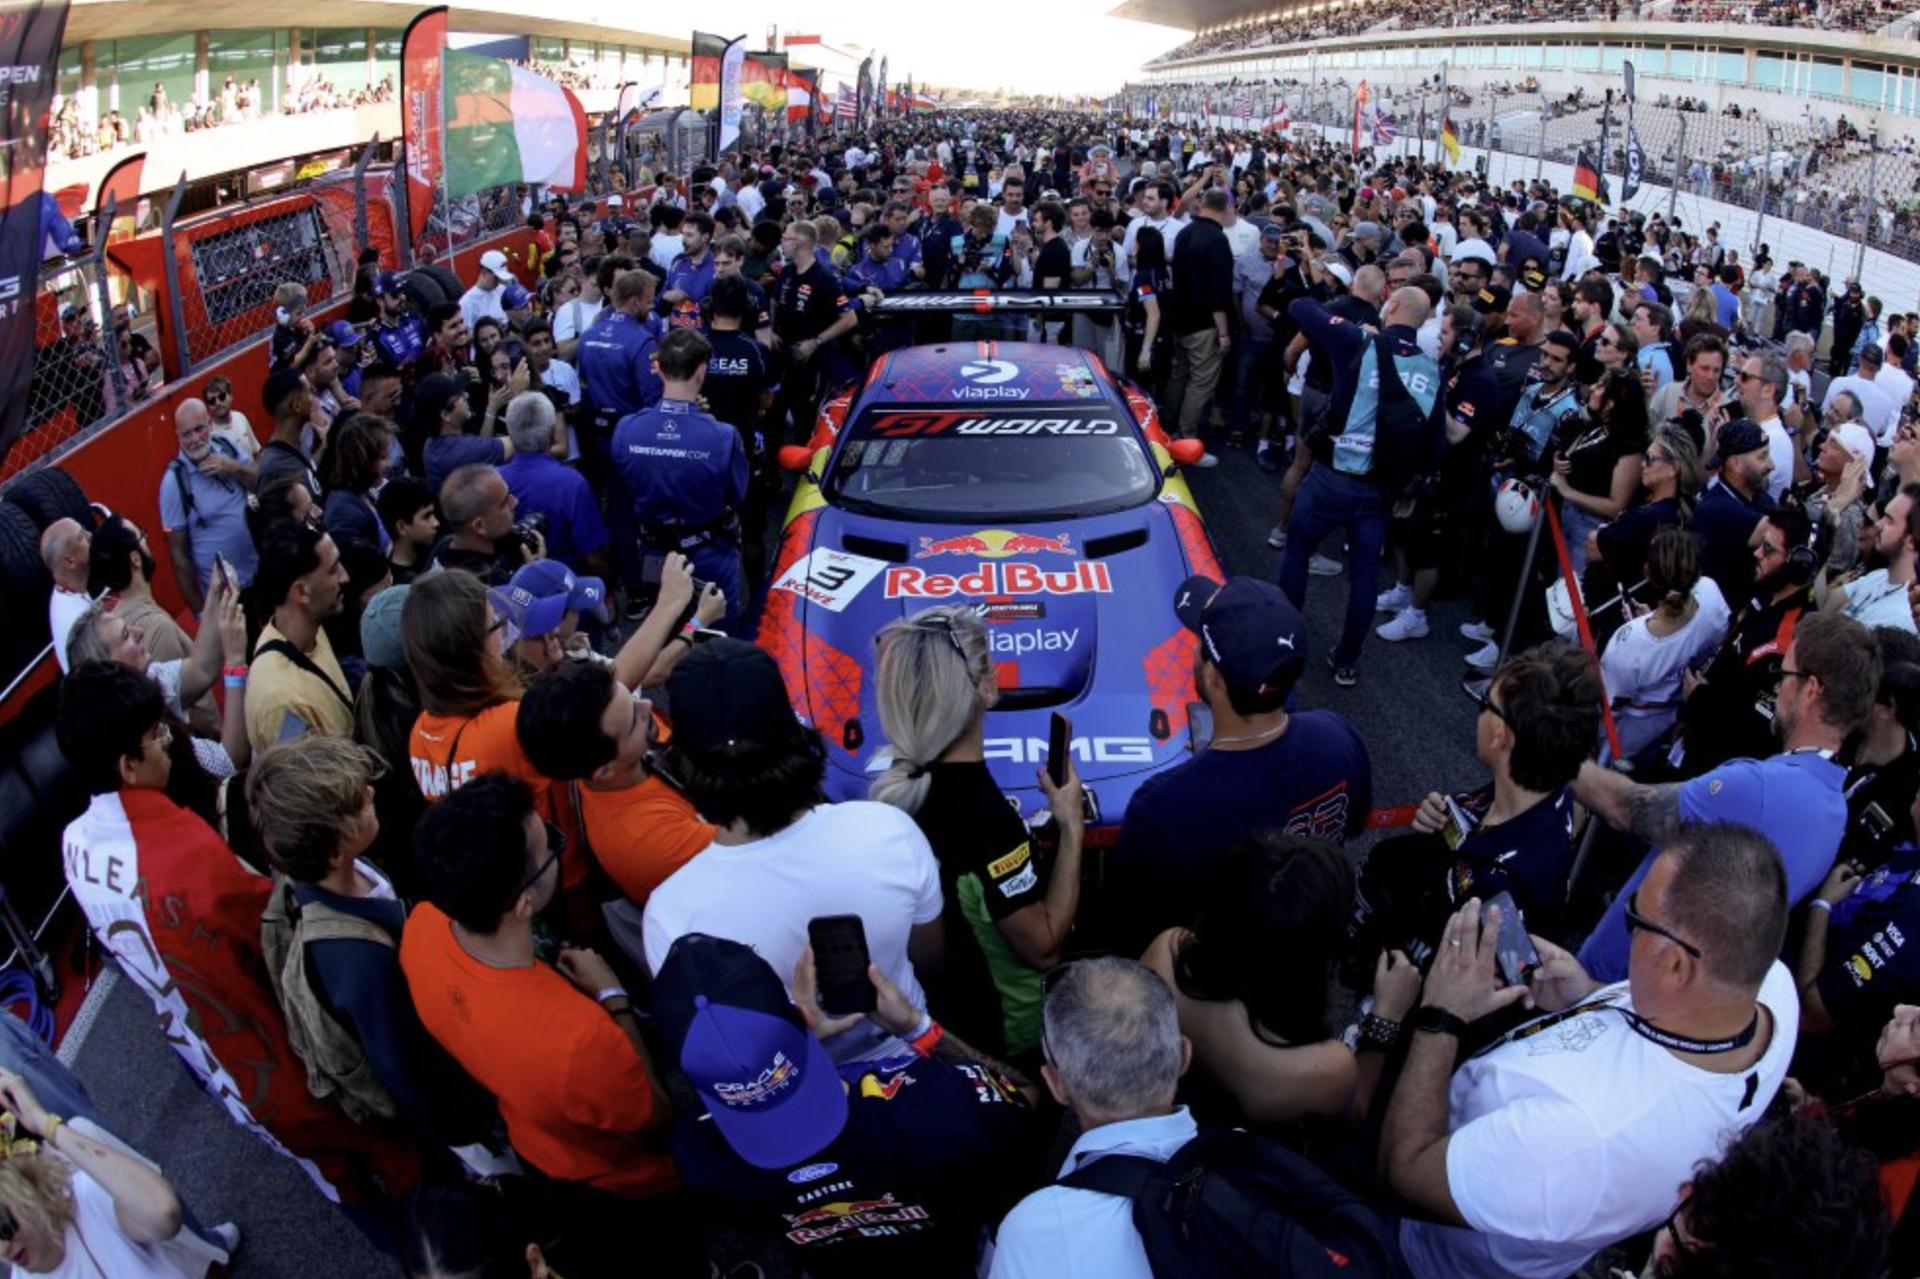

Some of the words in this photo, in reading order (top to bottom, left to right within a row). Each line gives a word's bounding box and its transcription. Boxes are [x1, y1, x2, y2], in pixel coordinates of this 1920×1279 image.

[952, 386, 1030, 400] viaplay
[873, 412, 987, 437] GT
[956, 418, 1119, 435] WORLD
[806, 565, 856, 591] 3
[884, 562, 997, 598] Red
[1002, 562, 1113, 595] Bull
[986, 627, 1079, 656] iaplay
[983, 736, 1153, 763] AMG
[786, 1215, 860, 1245] Red
